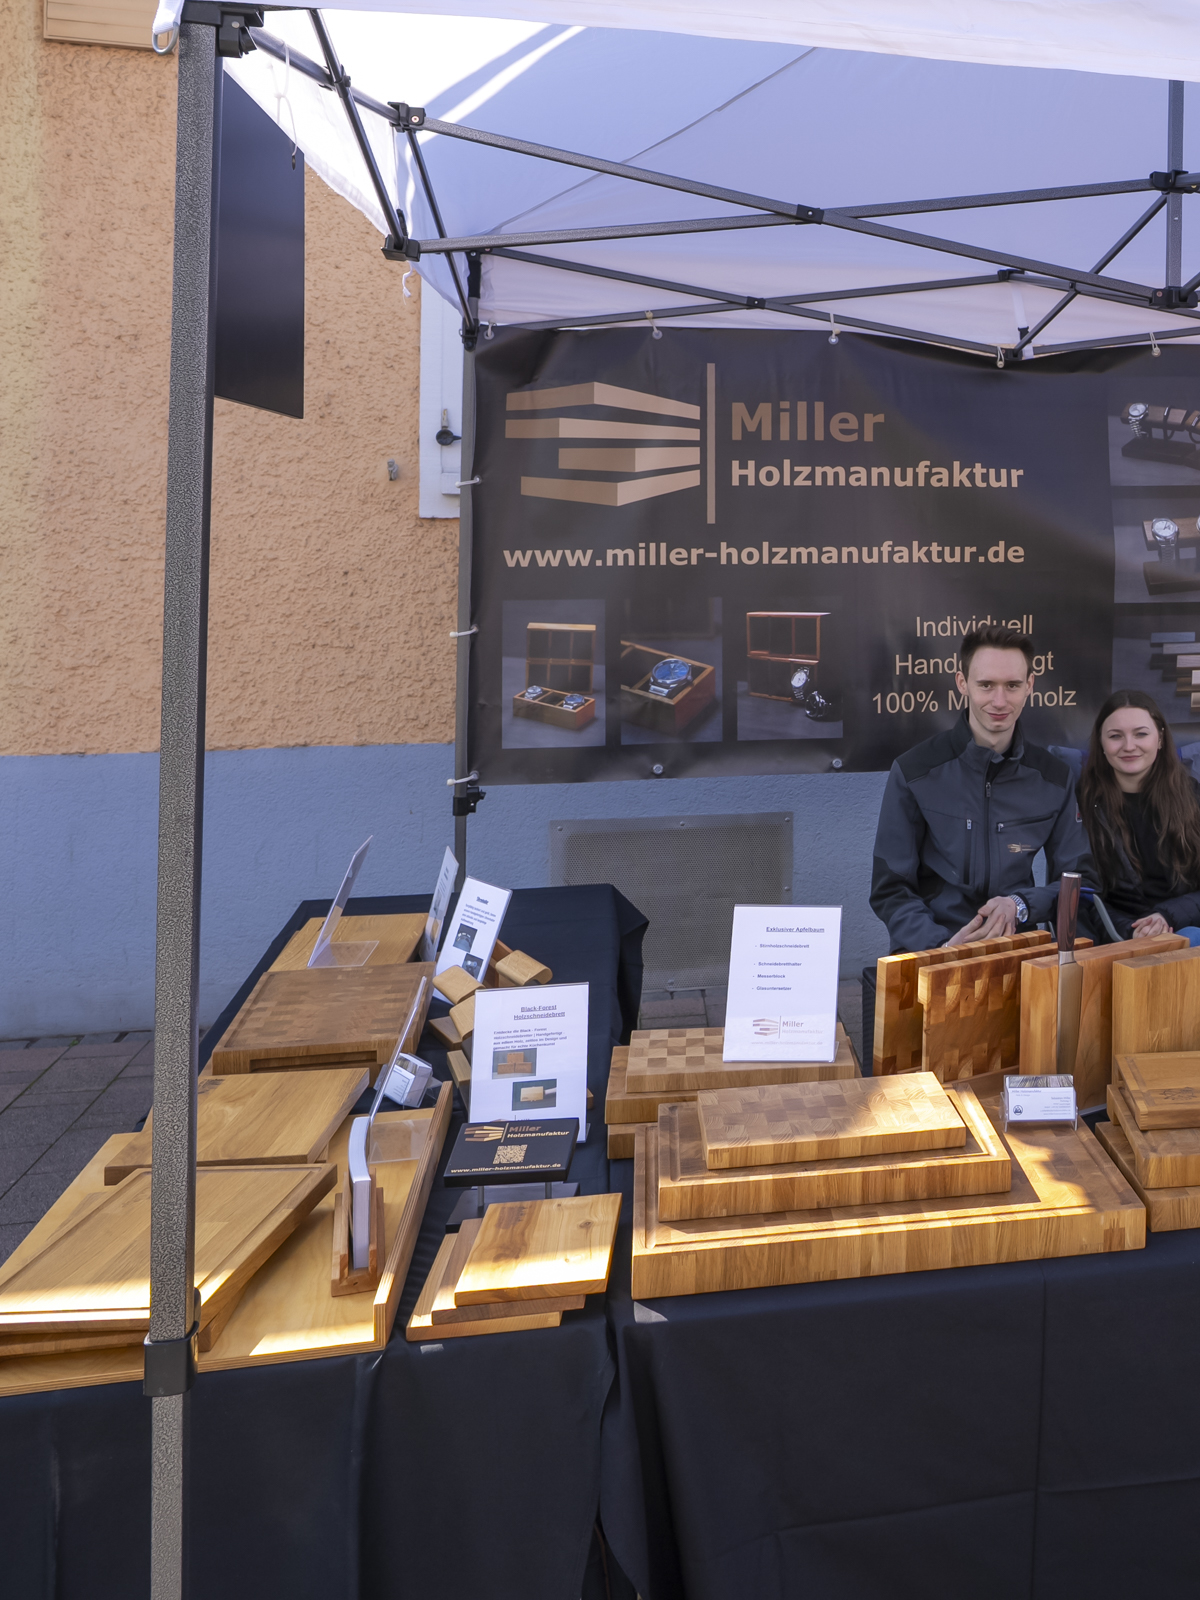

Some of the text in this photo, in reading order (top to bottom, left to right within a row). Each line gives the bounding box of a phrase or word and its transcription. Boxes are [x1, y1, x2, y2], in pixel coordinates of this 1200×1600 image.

[731, 401, 885, 442] Miller
[731, 459, 1024, 488] Holzmanufaktur
[503, 540, 1025, 568] www.miller-holzmanufaktur.de
[872, 691, 939, 714] 100%
[514, 1012, 565, 1021] Holzschneidebrett
[507, 1130, 570, 1139] Holzmanufaktur
[509, 1125, 542, 1133] Miller
[450, 1163, 562, 1174] www.miller-holzmanufaktur.de
